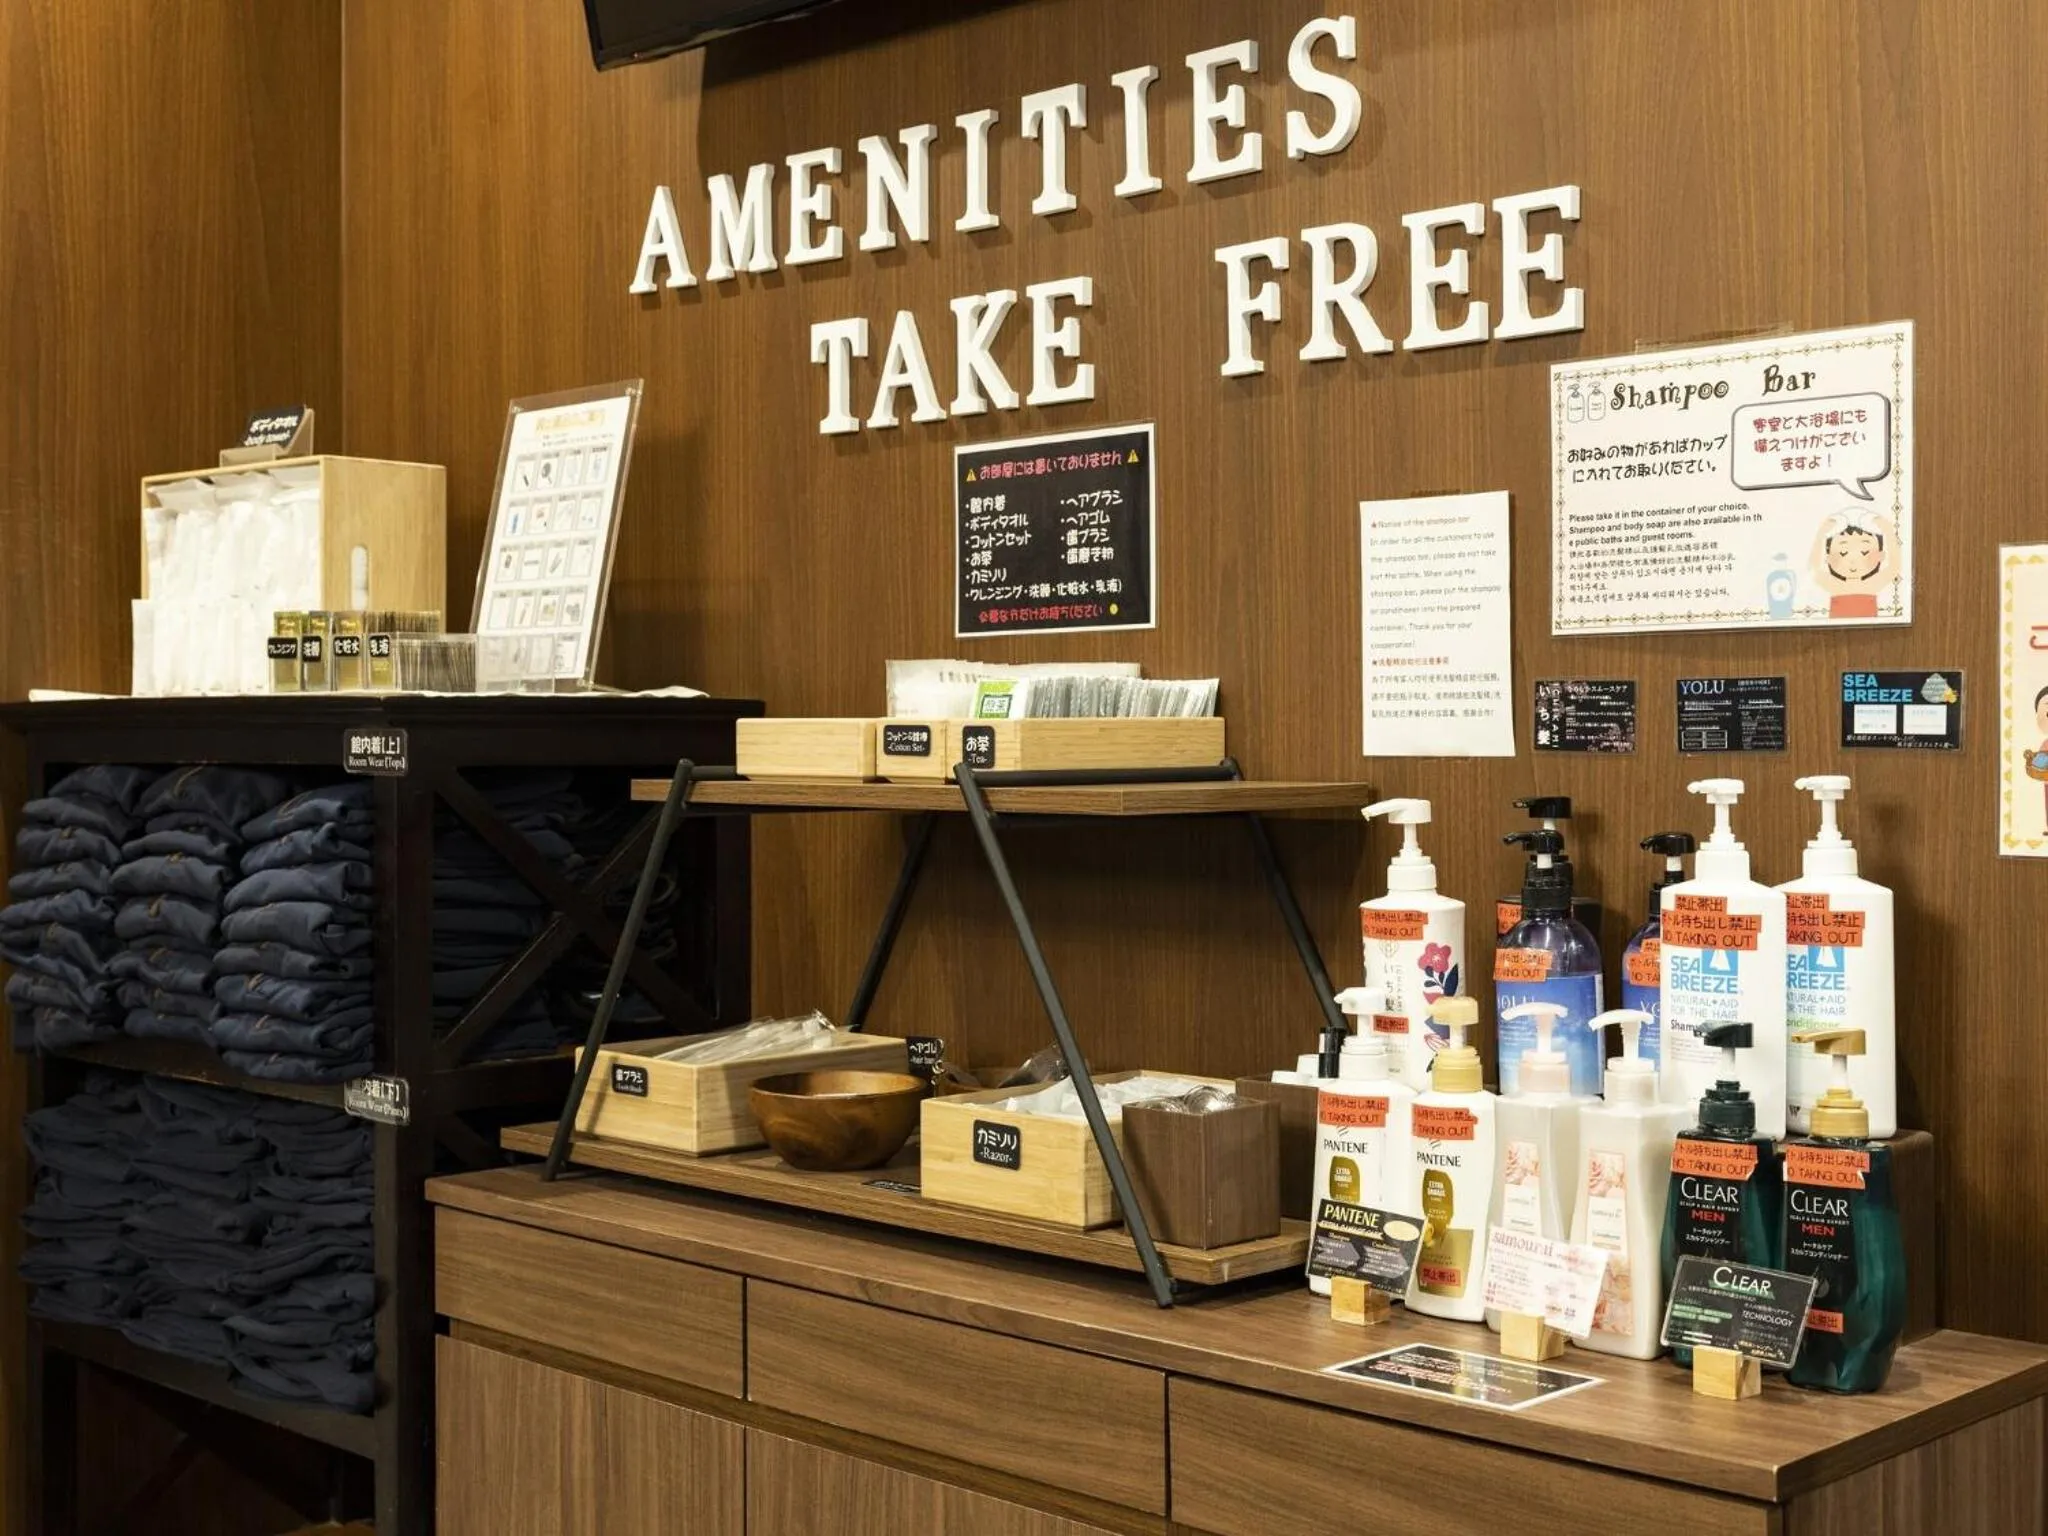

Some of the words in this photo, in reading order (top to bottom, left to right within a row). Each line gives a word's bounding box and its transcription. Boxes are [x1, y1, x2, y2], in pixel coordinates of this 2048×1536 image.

[629, 14, 1362, 296] AMENITIES
[809, 276, 1096, 435] TAKE
[1215, 184, 1585, 377] FREE
[1610, 380, 1729, 412] Shampoo
[1761, 363, 1816, 397] Bar
[1567, 434, 1728, 463] お好みの物があればカップ
[1572, 459, 1717, 484] に入れてお取りください。
[1621, 510, 1630, 518] in
[1631, 509, 1644, 518] the
[1646, 506, 1685, 517] container
[1687, 505, 1696, 514] of
[1697, 505, 1716, 515] your
[1607, 523, 1622, 532] and
[1624, 522, 1644, 532] body
[1668, 519, 1682, 528] are
[1683, 517, 1701, 526] also
[1703, 515, 1741, 525] available
[1624, 533, 1640, 542] and
[1680, 679, 1725, 696] YOLU
[1843, 674, 1878, 688] SEA
[1843, 688, 1913, 702] BREEZE
[965, 735, 990, 752] お茶
[1677, 931, 1717, 947] TAKING
[1722, 934, 1752, 947] OUT
[1827, 931, 1858, 944] OUT
[1671, 955, 1701, 973] SEA
[1671, 973, 1739, 994] BREEZE
[1359, 1114, 1380, 1123] OUT
[977, 1128, 1017, 1150] カミソリ
[1324, 1139, 1368, 1154] PANTENE
[1416, 1151, 1461, 1167] PANTENE
[1687, 1160, 1722, 1173] TAKING
[1726, 1164, 1750, 1175] OUT
[1800, 1168, 1833, 1181] TAKING
[1836, 1171, 1859, 1183] OUT
[1681, 1176, 1738, 1204] CLEAR
[1790, 1189, 1849, 1217] CLEAR
[1324, 1204, 1381, 1229] PANTENE
[1691, 1209, 1725, 1222] MEN
[1801, 1223, 1835, 1236] MEN
[1713, 1266, 1771, 1296] CLEAR
[1742, 1309, 1793, 1326] TECHNOLOGY
